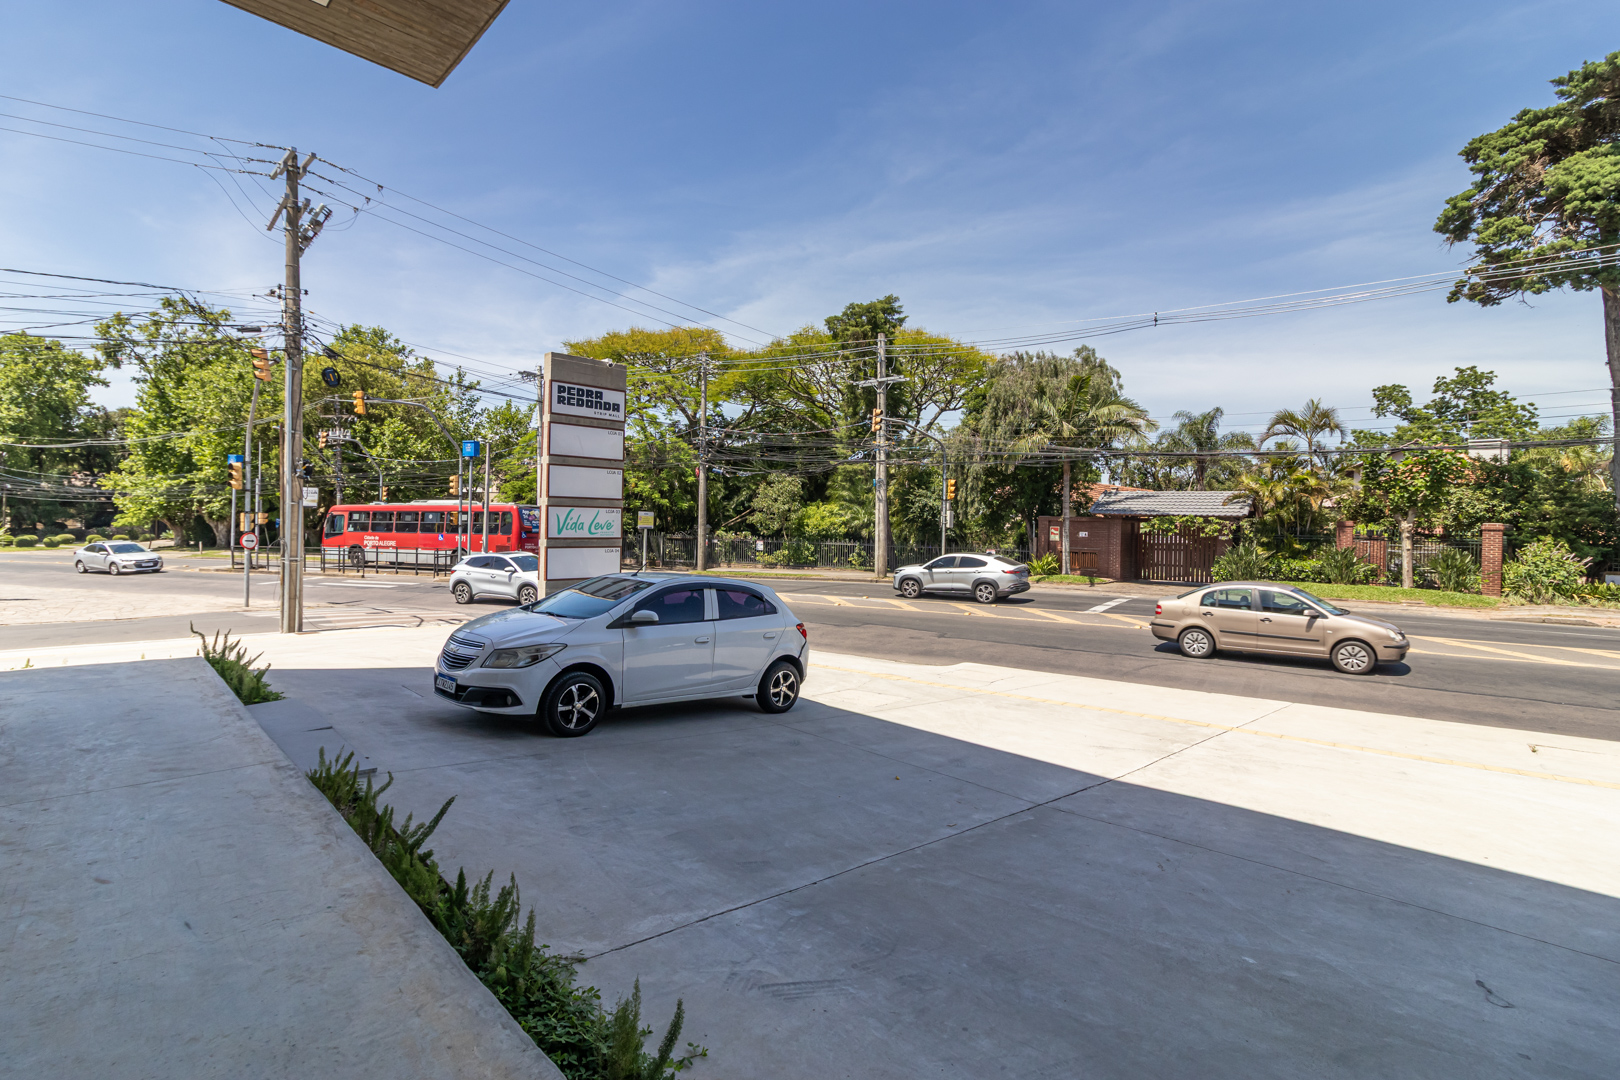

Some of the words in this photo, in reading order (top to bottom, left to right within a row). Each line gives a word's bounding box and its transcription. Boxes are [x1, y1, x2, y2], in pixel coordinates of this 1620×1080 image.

[557, 384, 603, 400] PEDRA
[557, 394, 620, 413] REDONDA
[556, 508, 584, 535] Vida
[588, 509, 614, 535] Leve
